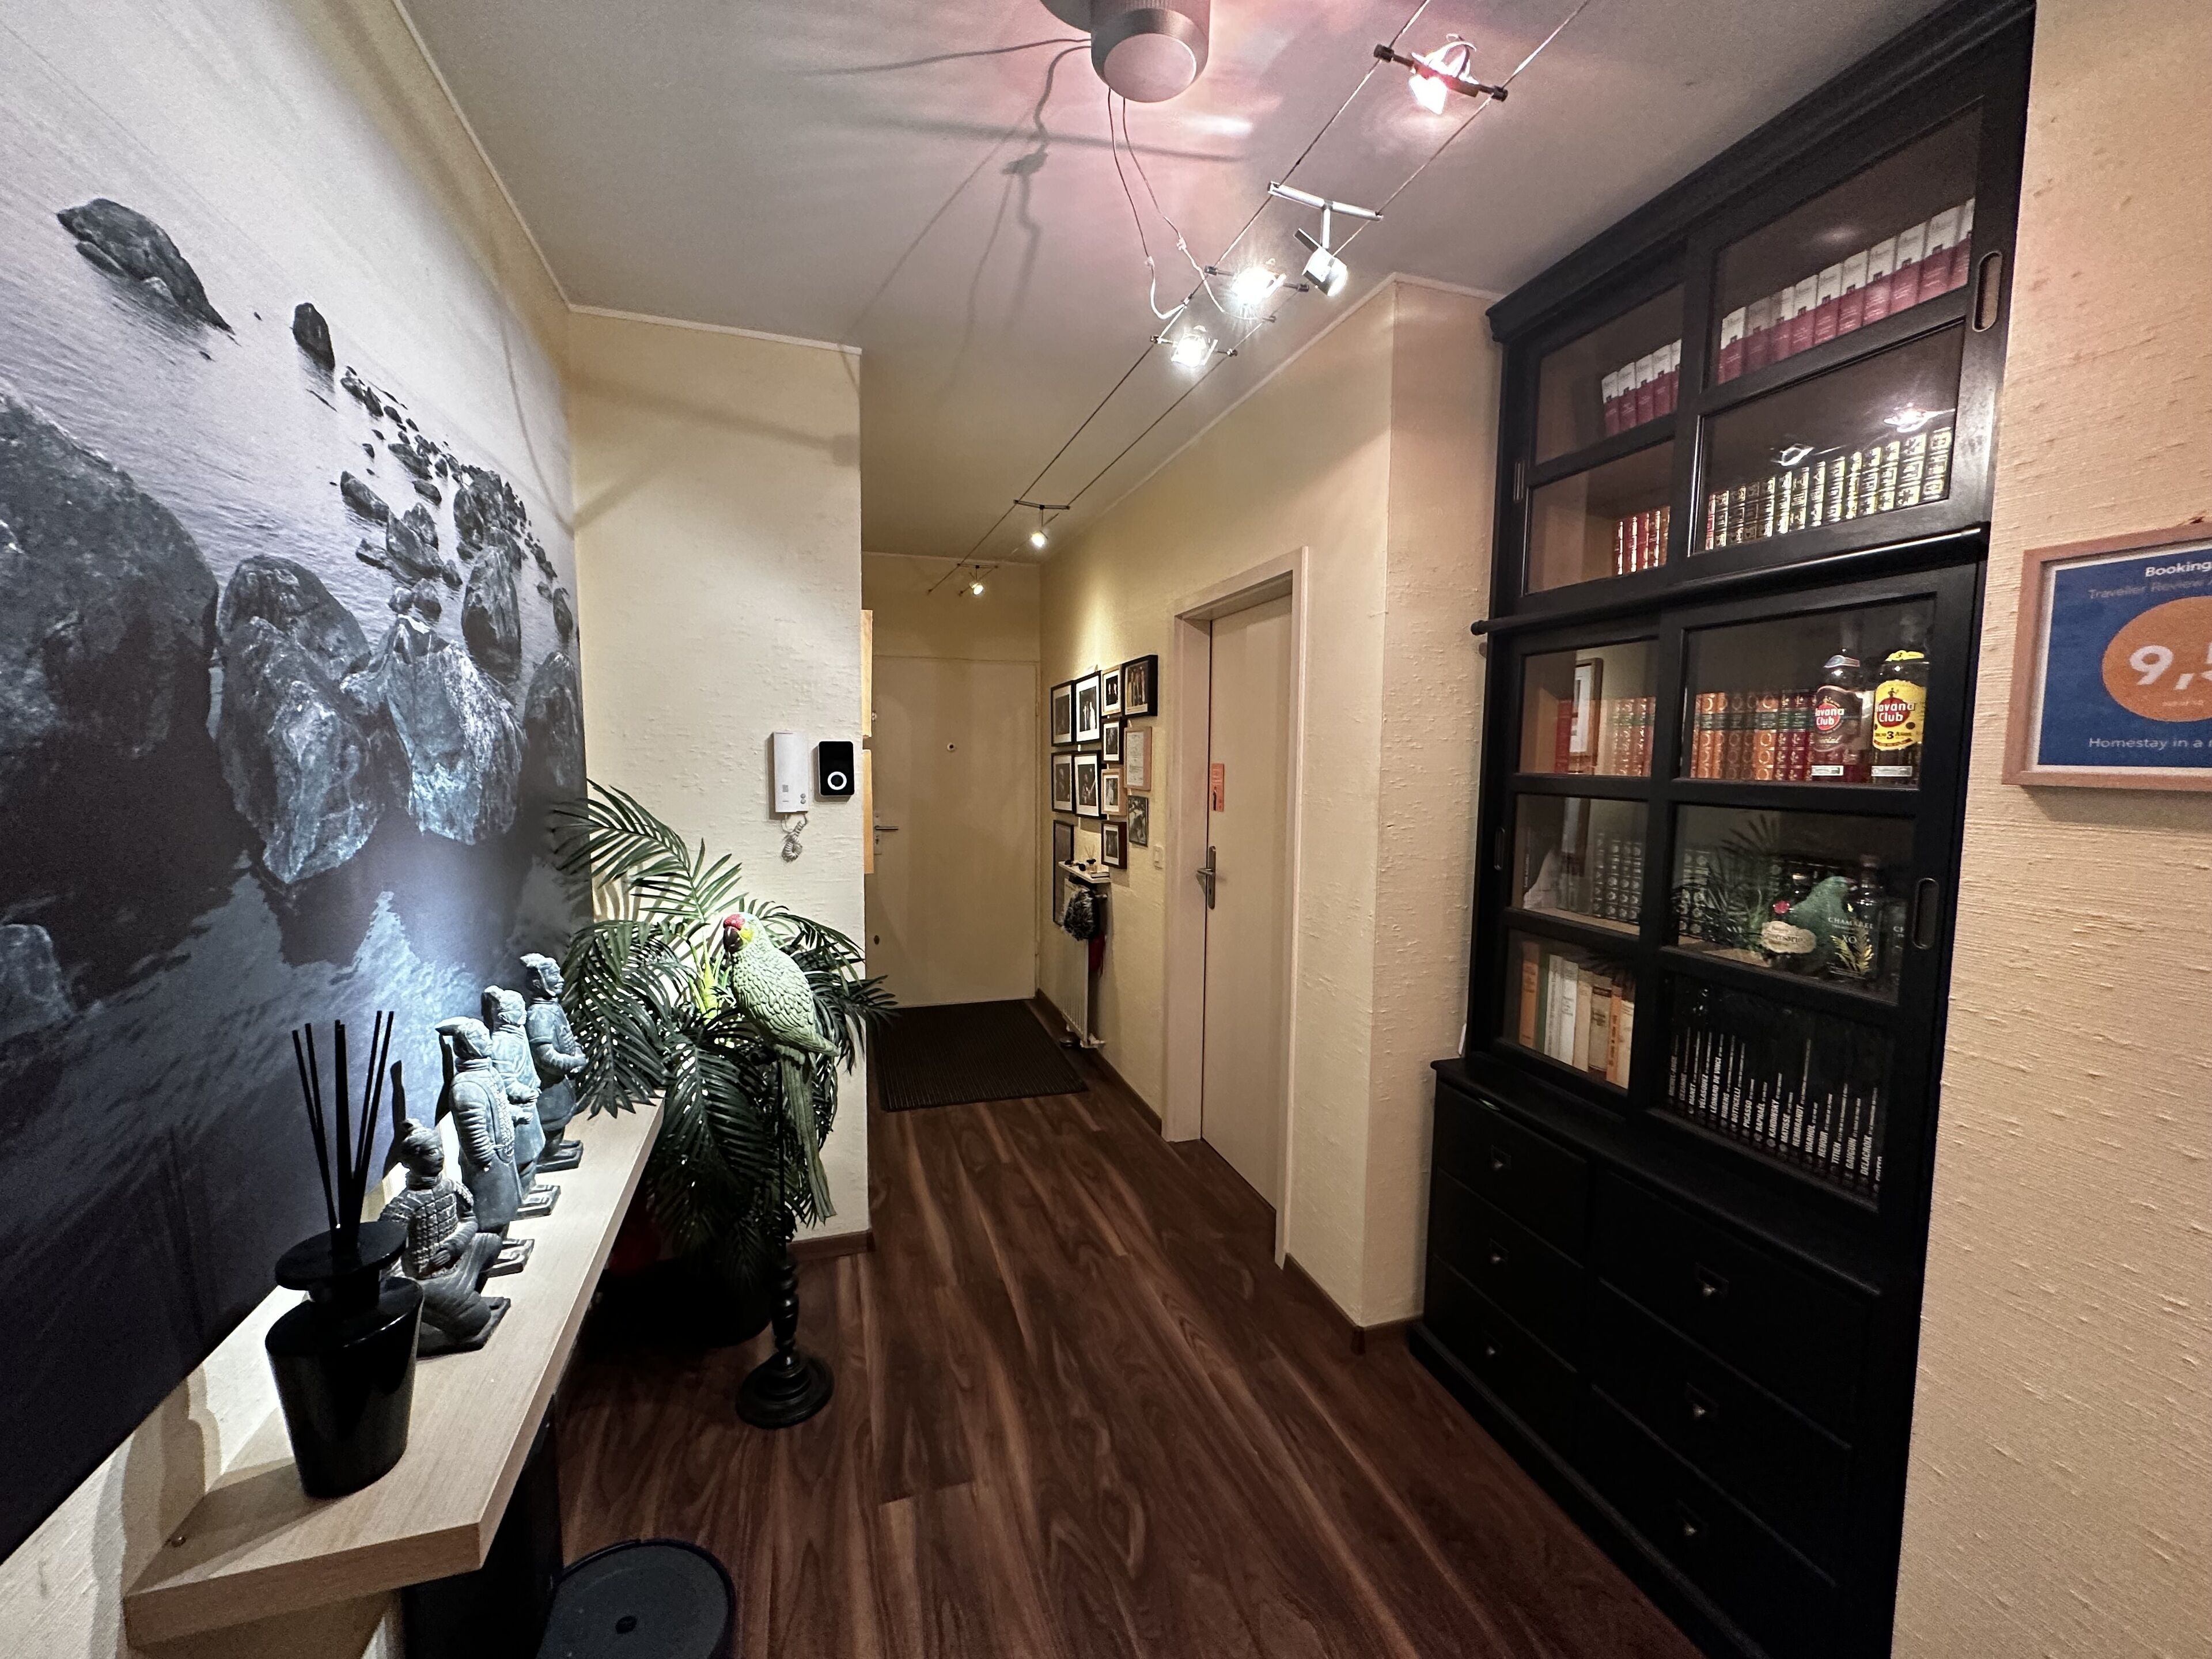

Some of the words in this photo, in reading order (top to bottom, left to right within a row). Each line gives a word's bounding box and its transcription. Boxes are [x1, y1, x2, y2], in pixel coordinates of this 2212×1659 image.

[2145, 562, 2212, 577] Booking
[1816, 716, 1835, 726] Club
[1878, 712, 1904, 722] Club
[2089, 737, 2167, 751] Homestay
[2172, 738, 2188, 748] in
[2192, 739, 2203, 748] a
[1713, 1073, 1721, 1085] DE
[1714, 1056, 1722, 1075] VINCI
[1688, 1082, 1696, 1106] MANET
[1709, 1084, 1719, 1115] LÉONARD
[1721, 1092, 1730, 1119] RUBENS
[1731, 1087, 1741, 1124] BOTTICELLI
[1743, 1099, 1753, 1128] PICASSO
[1767, 1099, 1780, 1138] KANDINSKY
[1791, 1103, 1805, 1148] REMBRANDT
[1780, 1113, 1791, 1143] MATISSE
[1804, 1124, 1816, 1153] WARHOL
[1817, 1131, 1829, 1158] RENOIR
[1831, 1141, 1842, 1164] TITIEN
[1845, 1137, 1857, 1170] GAUGUIN
[1859, 1134, 1873, 1176] DELACROIX
